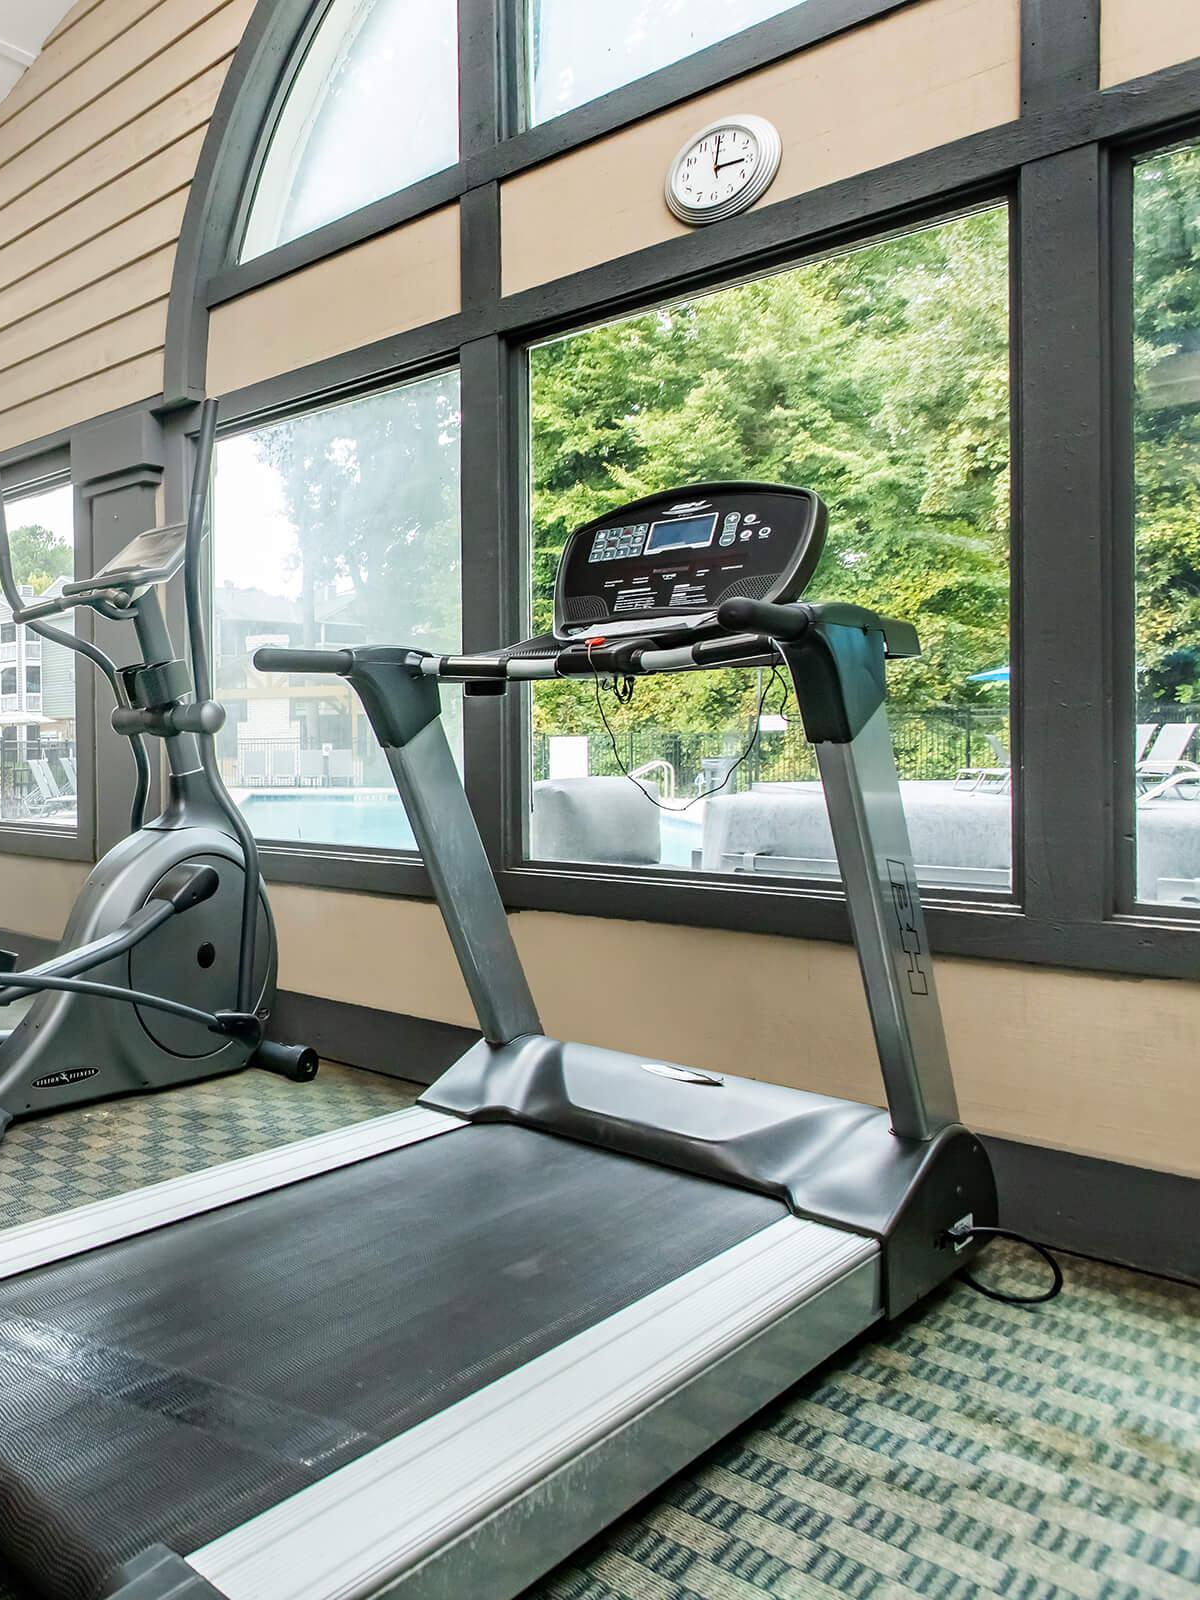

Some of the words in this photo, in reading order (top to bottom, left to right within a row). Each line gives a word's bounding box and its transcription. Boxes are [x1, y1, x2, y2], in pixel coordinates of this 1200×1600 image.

[699, 141, 708, 153] 11
[742, 139, 750, 150] 2
[686, 156, 697, 168] 10
[725, 183, 734, 194] 5
[696, 191, 704, 202] 7
[709, 191, 718, 201] 6
[69, 1069, 95, 1079] FITNESS
